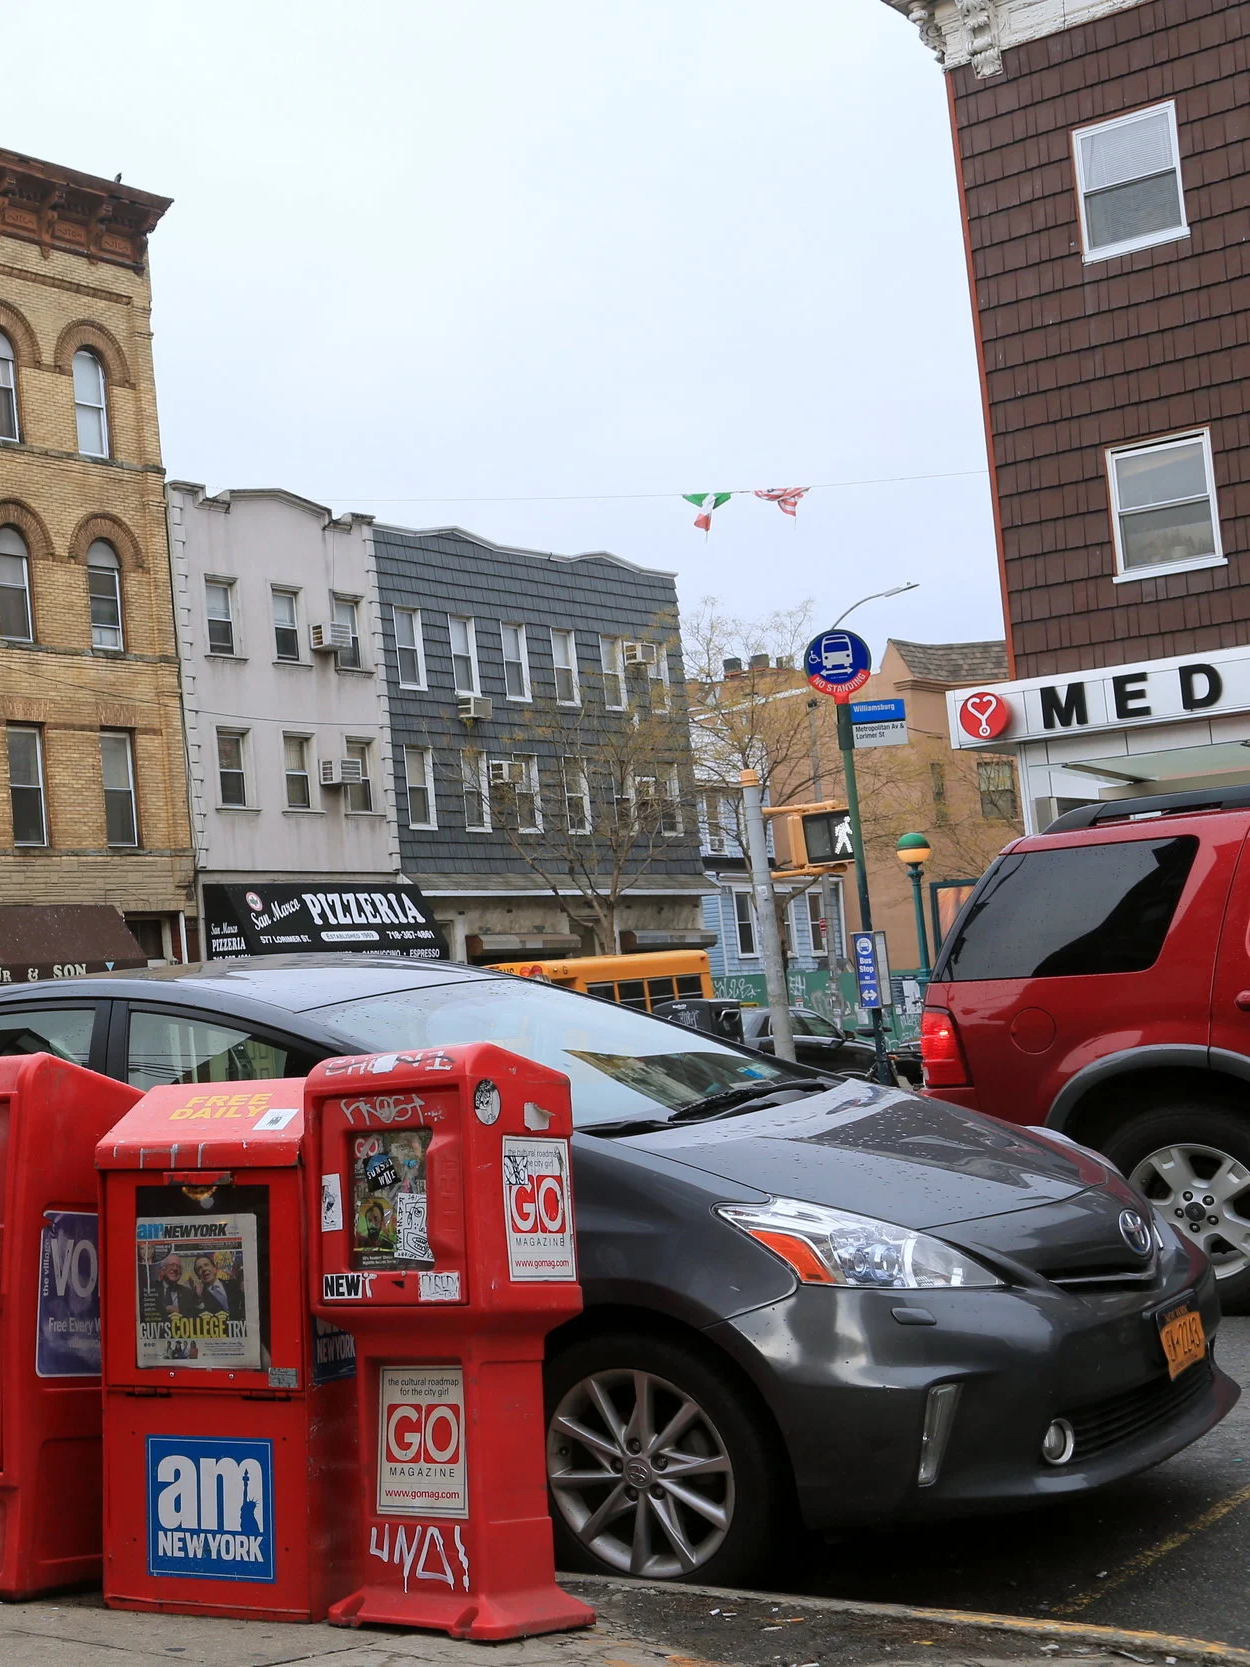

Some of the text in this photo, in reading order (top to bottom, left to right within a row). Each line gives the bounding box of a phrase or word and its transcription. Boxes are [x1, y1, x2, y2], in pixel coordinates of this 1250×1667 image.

[813, 672, 866, 693] NO STANDING
[853, 703, 895, 713] Williamsburg
[855, 724, 890, 733] Metropolitan
[856, 732, 877, 740] Lorimer
[250, 892, 426, 931] San Marco PIZZERIA
[212, 937, 247, 952] PIZZERIA
[260, 934, 312, 944] 577 LORIMER ST.
[410, 948, 440, 958] ESPRESSO
[27, 968, 38, 982] &
[52, 963, 87, 978] SON
[858, 957, 874, 974] Bus Stop
[185, 1093, 273, 1108] FREE
[168, 1105, 270, 1120] DAILY
[534, 1159, 544, 1169] city
[510, 1176, 563, 1232] GO
[515, 1237, 565, 1247] MAGAZINE
[515, 1259, 570, 1270] www.gomag.com
[324, 1274, 361, 1297] NEW
[48, 1317, 67, 1332] Free
[69, 1317, 94, 1336] Every
[171, 1315, 227, 1339] COLLEGE
[226, 1320, 248, 1338] TRY
[388, 1377, 460, 1388] the cultural roadmap
[400, 1387, 449, 1399] for the city girl
[387, 1405, 459, 1462] GO
[389, 1466, 456, 1478] MAGAZINE
[157, 1455, 264, 1533] am
[384, 1488, 460, 1501] www.gomag.com
